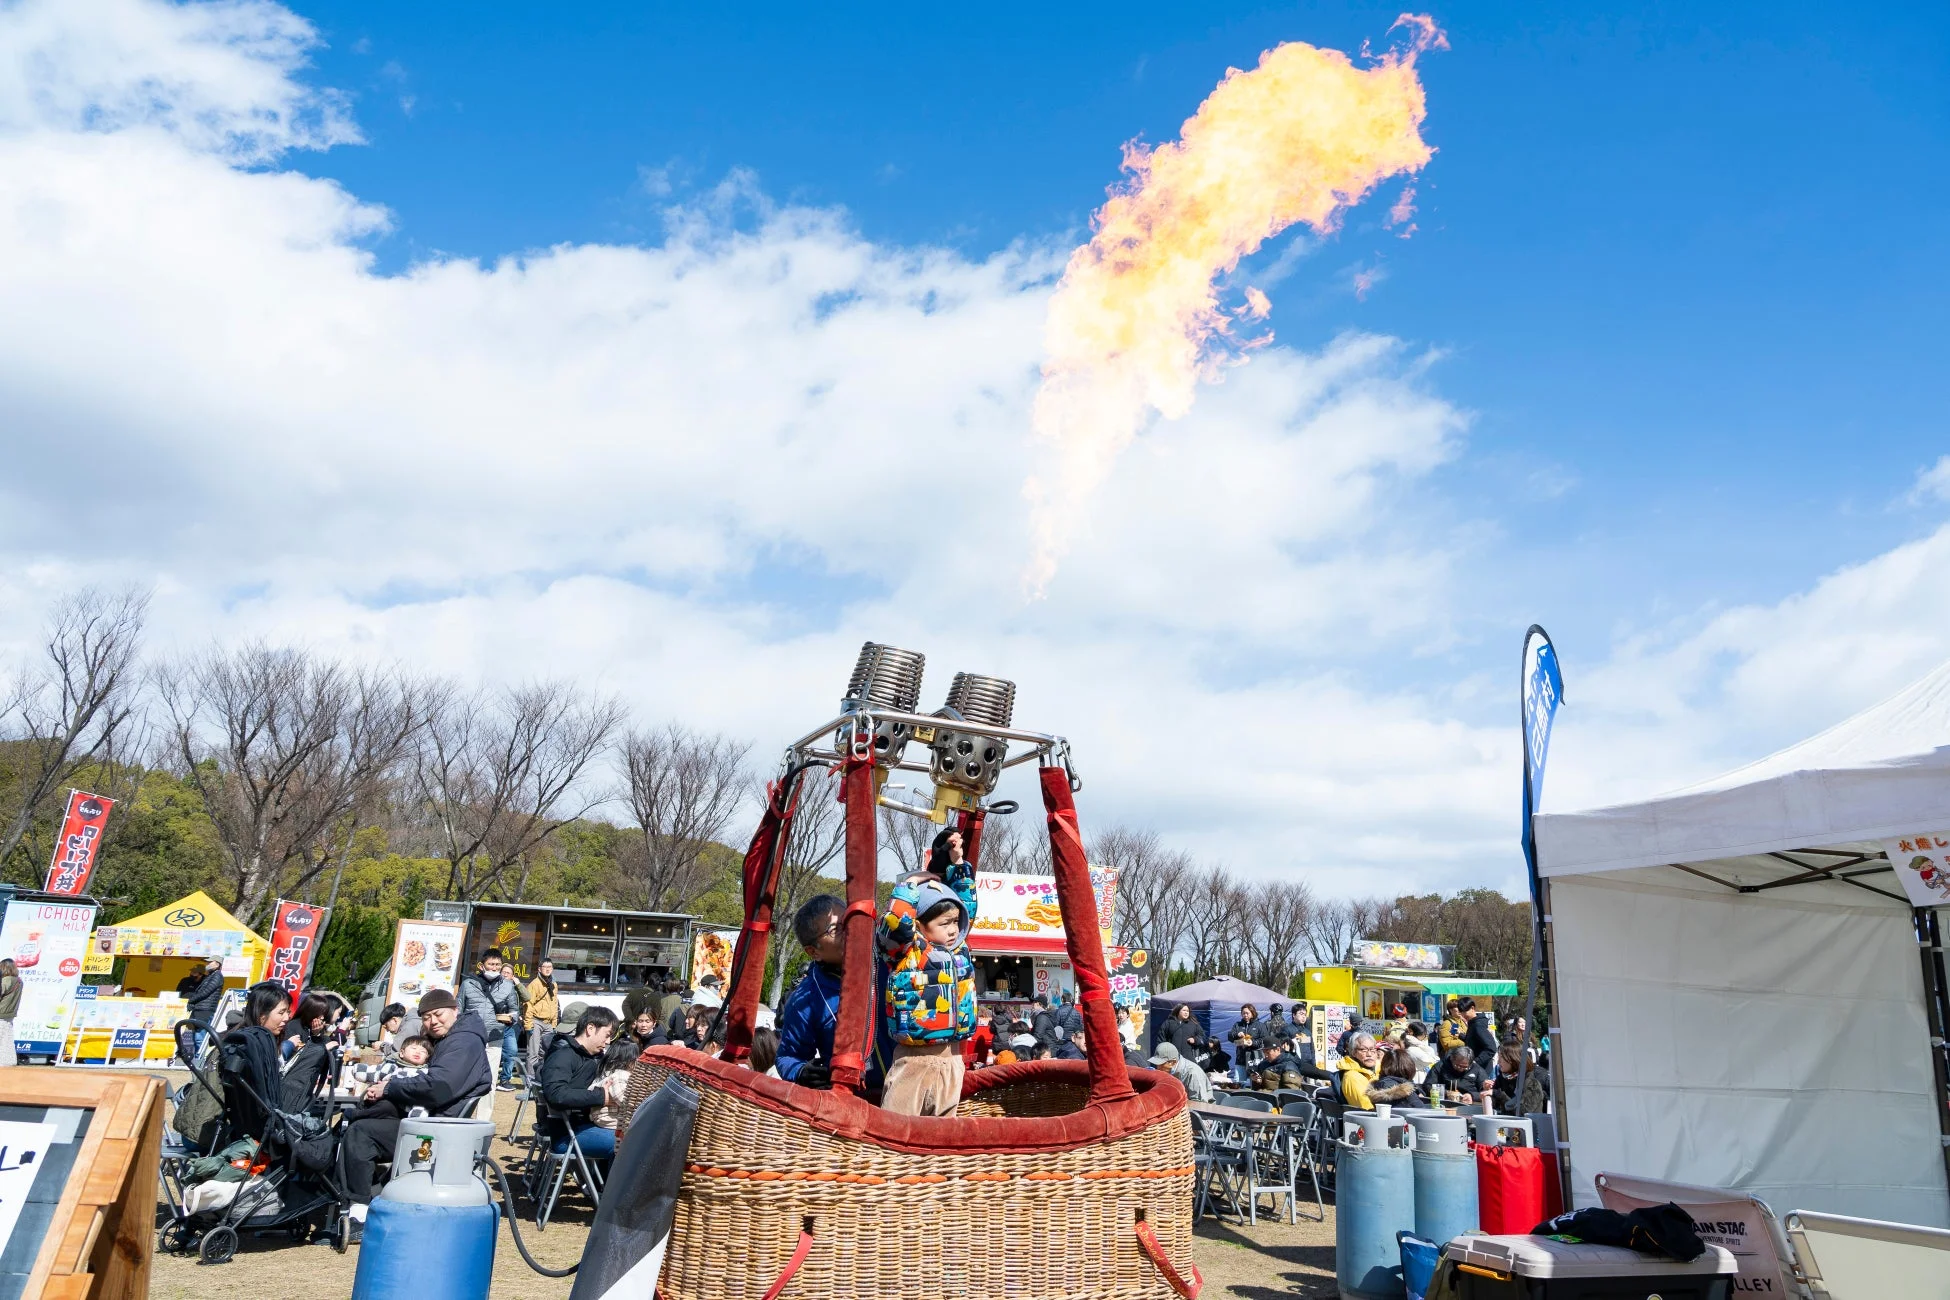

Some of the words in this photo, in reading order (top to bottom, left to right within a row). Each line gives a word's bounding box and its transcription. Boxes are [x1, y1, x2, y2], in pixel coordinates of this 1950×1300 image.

[76, 825, 99, 877] ロースト
[54, 834, 86, 891] ビーフ丼
[37, 905, 91, 922] ICHIGO
[63, 922, 87, 932] MILK
[1007, 918, 1040, 932] Time
[1115, 989, 1150, 1004] ポテト
[20, 1031, 63, 1040] MATCHA
